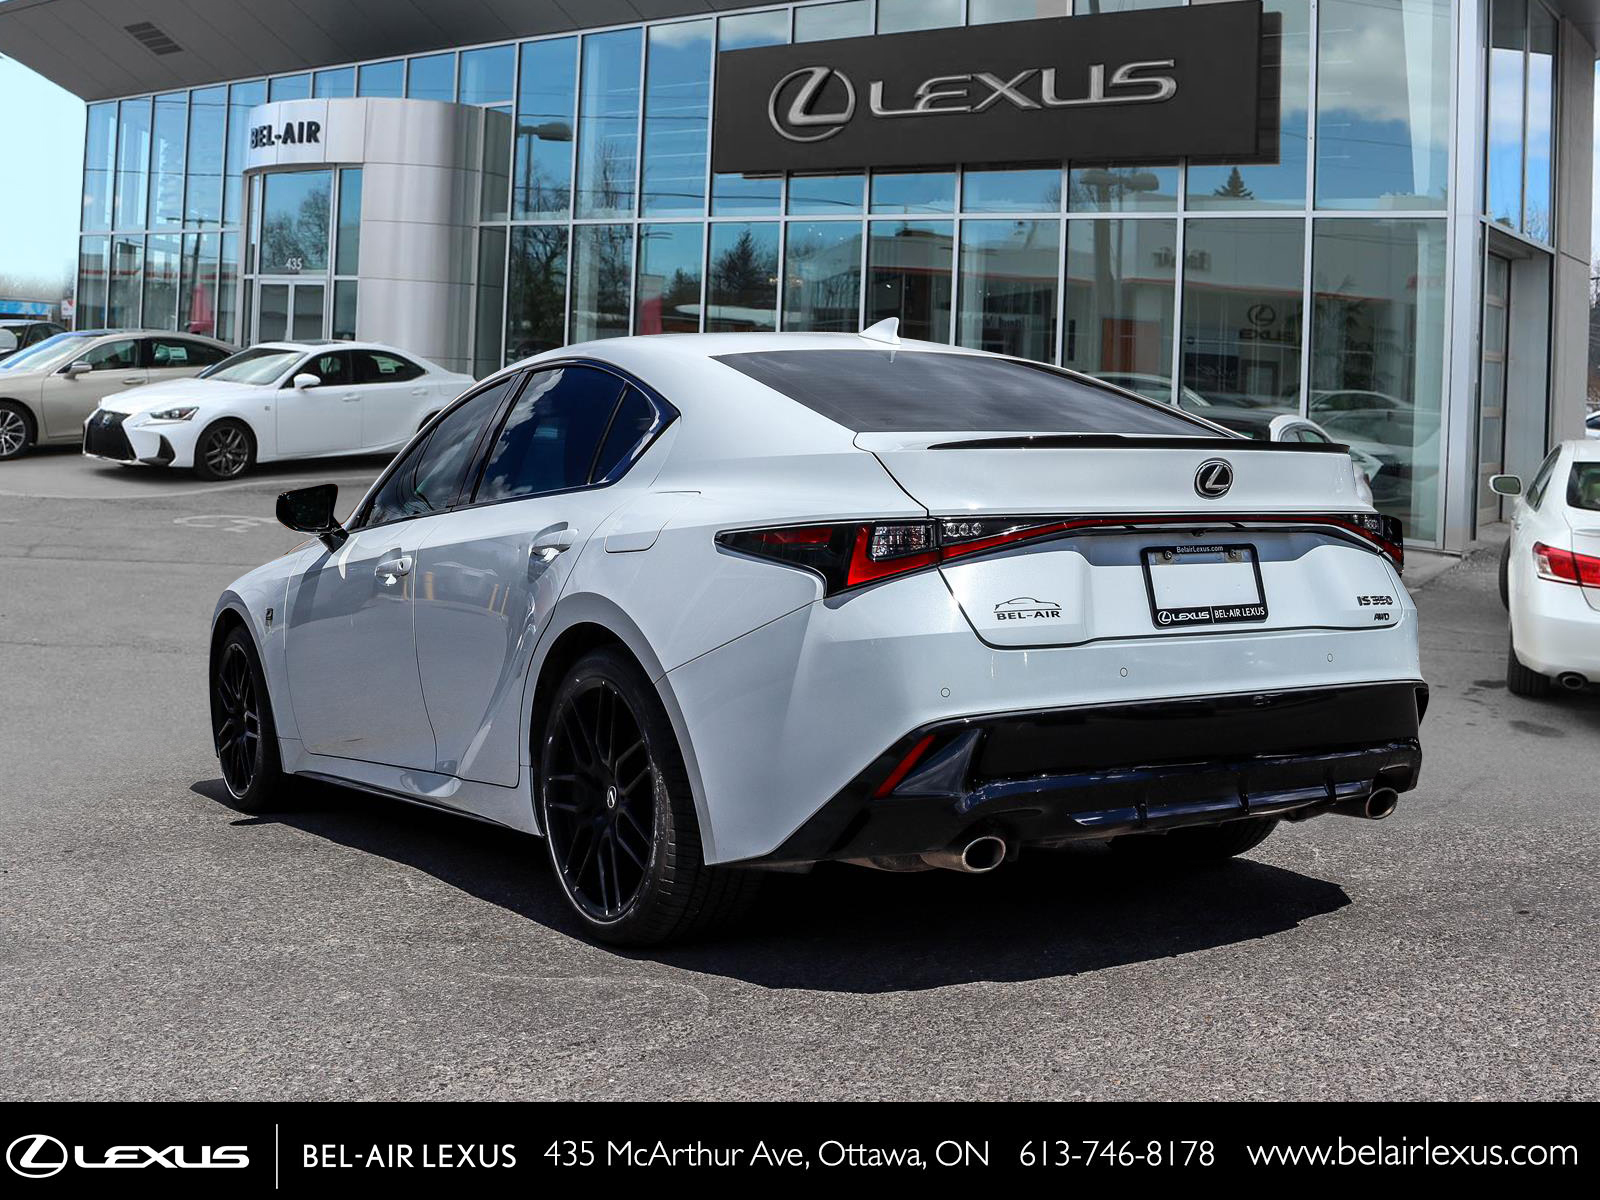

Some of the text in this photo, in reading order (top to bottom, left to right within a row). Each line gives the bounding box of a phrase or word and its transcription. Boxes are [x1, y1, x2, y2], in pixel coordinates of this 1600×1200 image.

[869, 59, 1177, 118] LEXUS
[250, 120, 321, 149] BEL-AIR
[286, 257, 303, 270] 435
[1176, 545, 1224, 553] BelairLexus.com
[1370, 595, 1393, 606] 350
[996, 610, 1061, 621] BEL-AIR
[1171, 611, 1210, 621] LEXUS
[1213, 606, 1266, 619] BEL-AIR LEXUS
[1373, 612, 1390, 621] AWD
